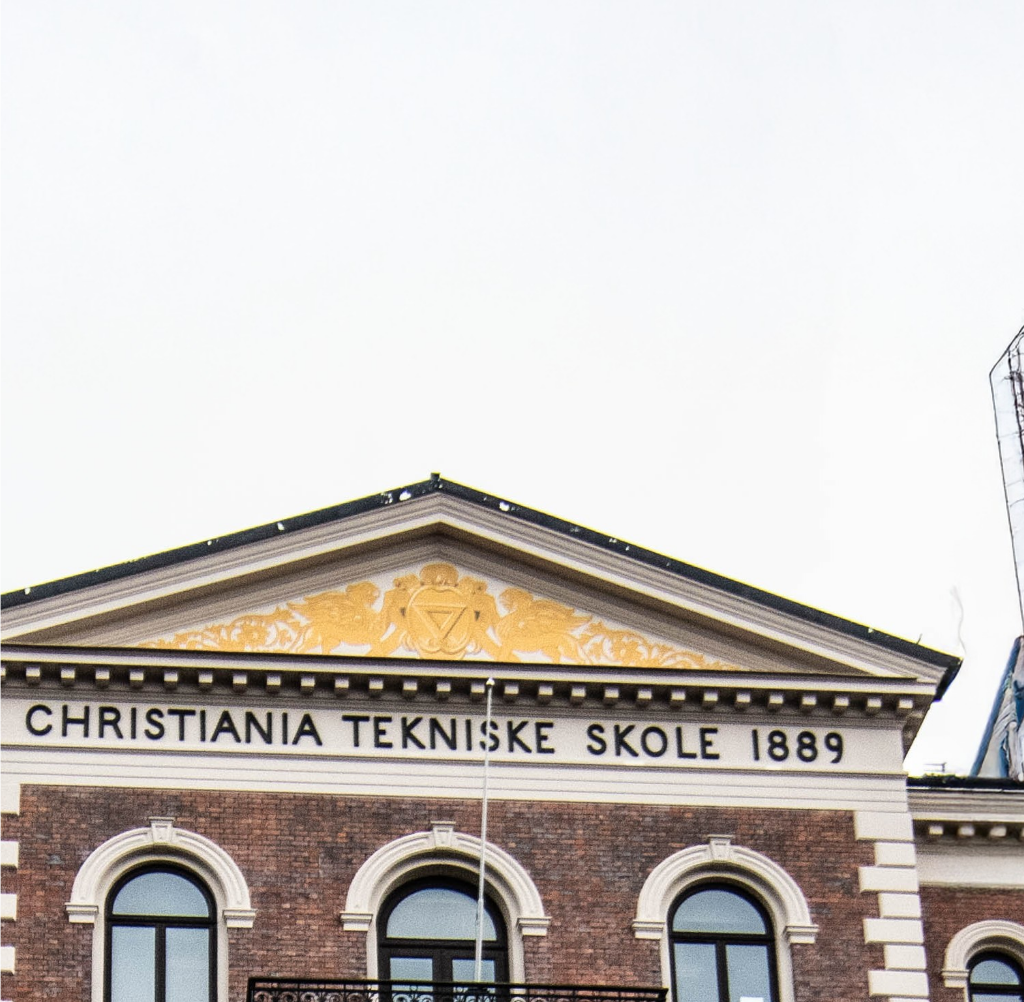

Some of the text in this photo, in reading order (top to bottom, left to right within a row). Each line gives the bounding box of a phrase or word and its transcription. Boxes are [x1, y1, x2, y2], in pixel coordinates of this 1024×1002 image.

[25, 703, 844, 764] CHRISTIANIA TEKNISKE SKOLE 1889
